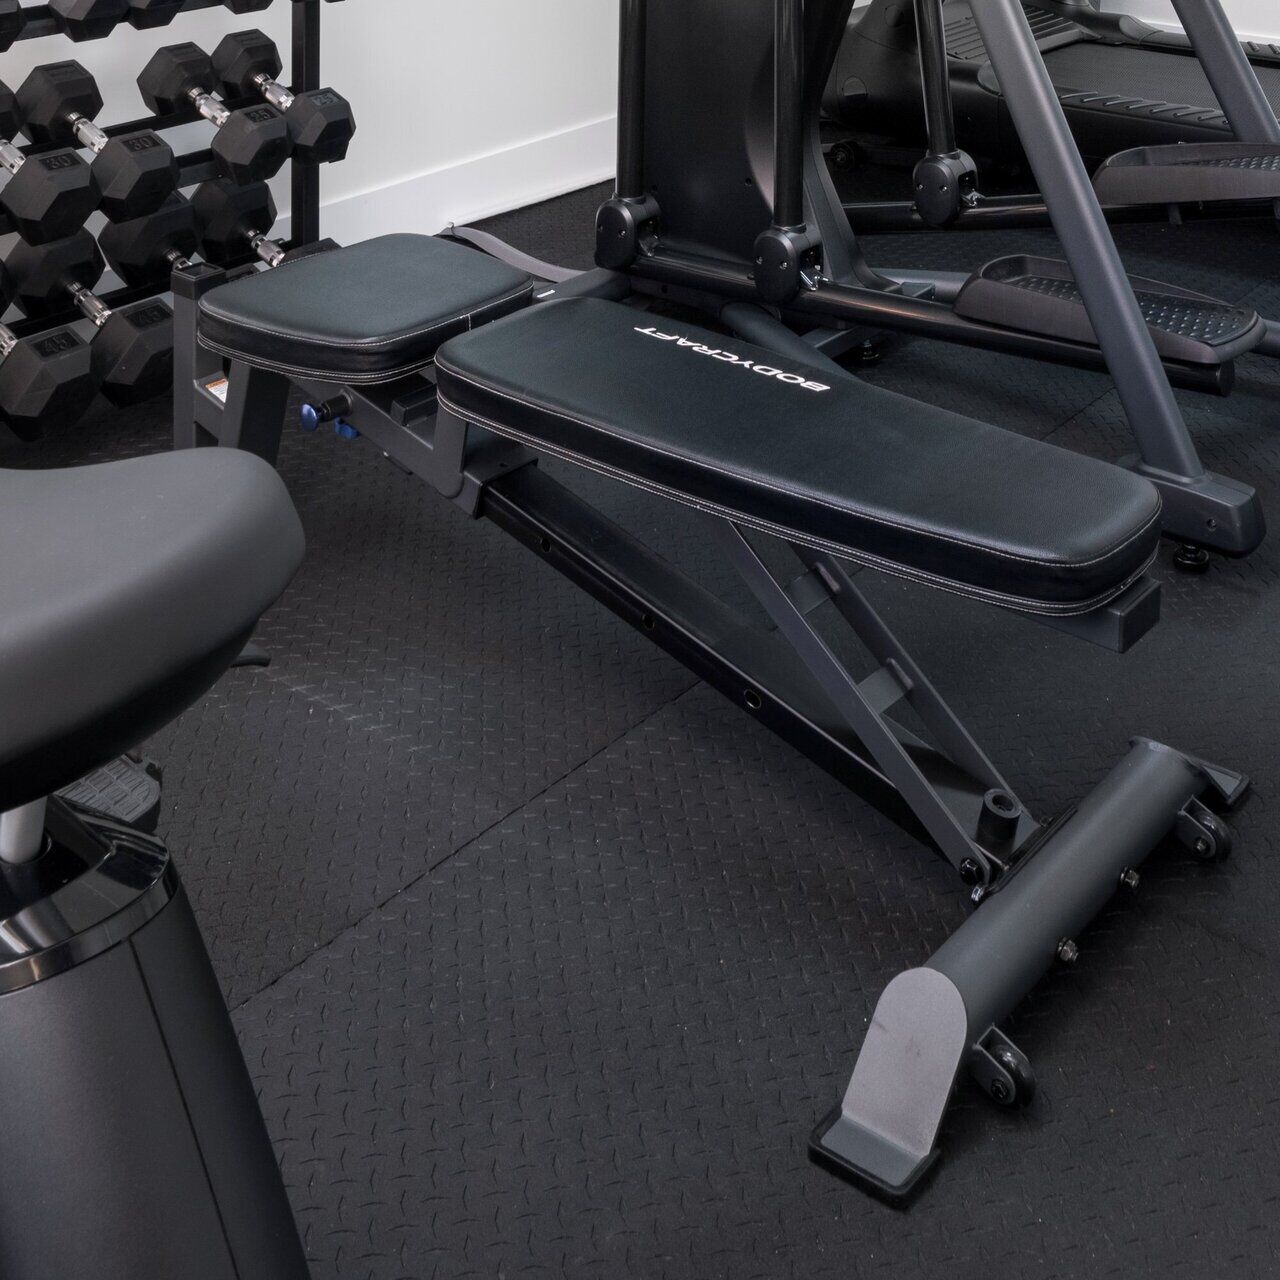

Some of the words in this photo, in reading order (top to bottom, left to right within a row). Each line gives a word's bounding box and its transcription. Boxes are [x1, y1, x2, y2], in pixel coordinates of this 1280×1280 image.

[314, 93, 334, 105] 25
[131, 139, 152, 151] 30
[46, 154, 71, 169] 30
[633, 326, 831, 393] BODYCRAFT
